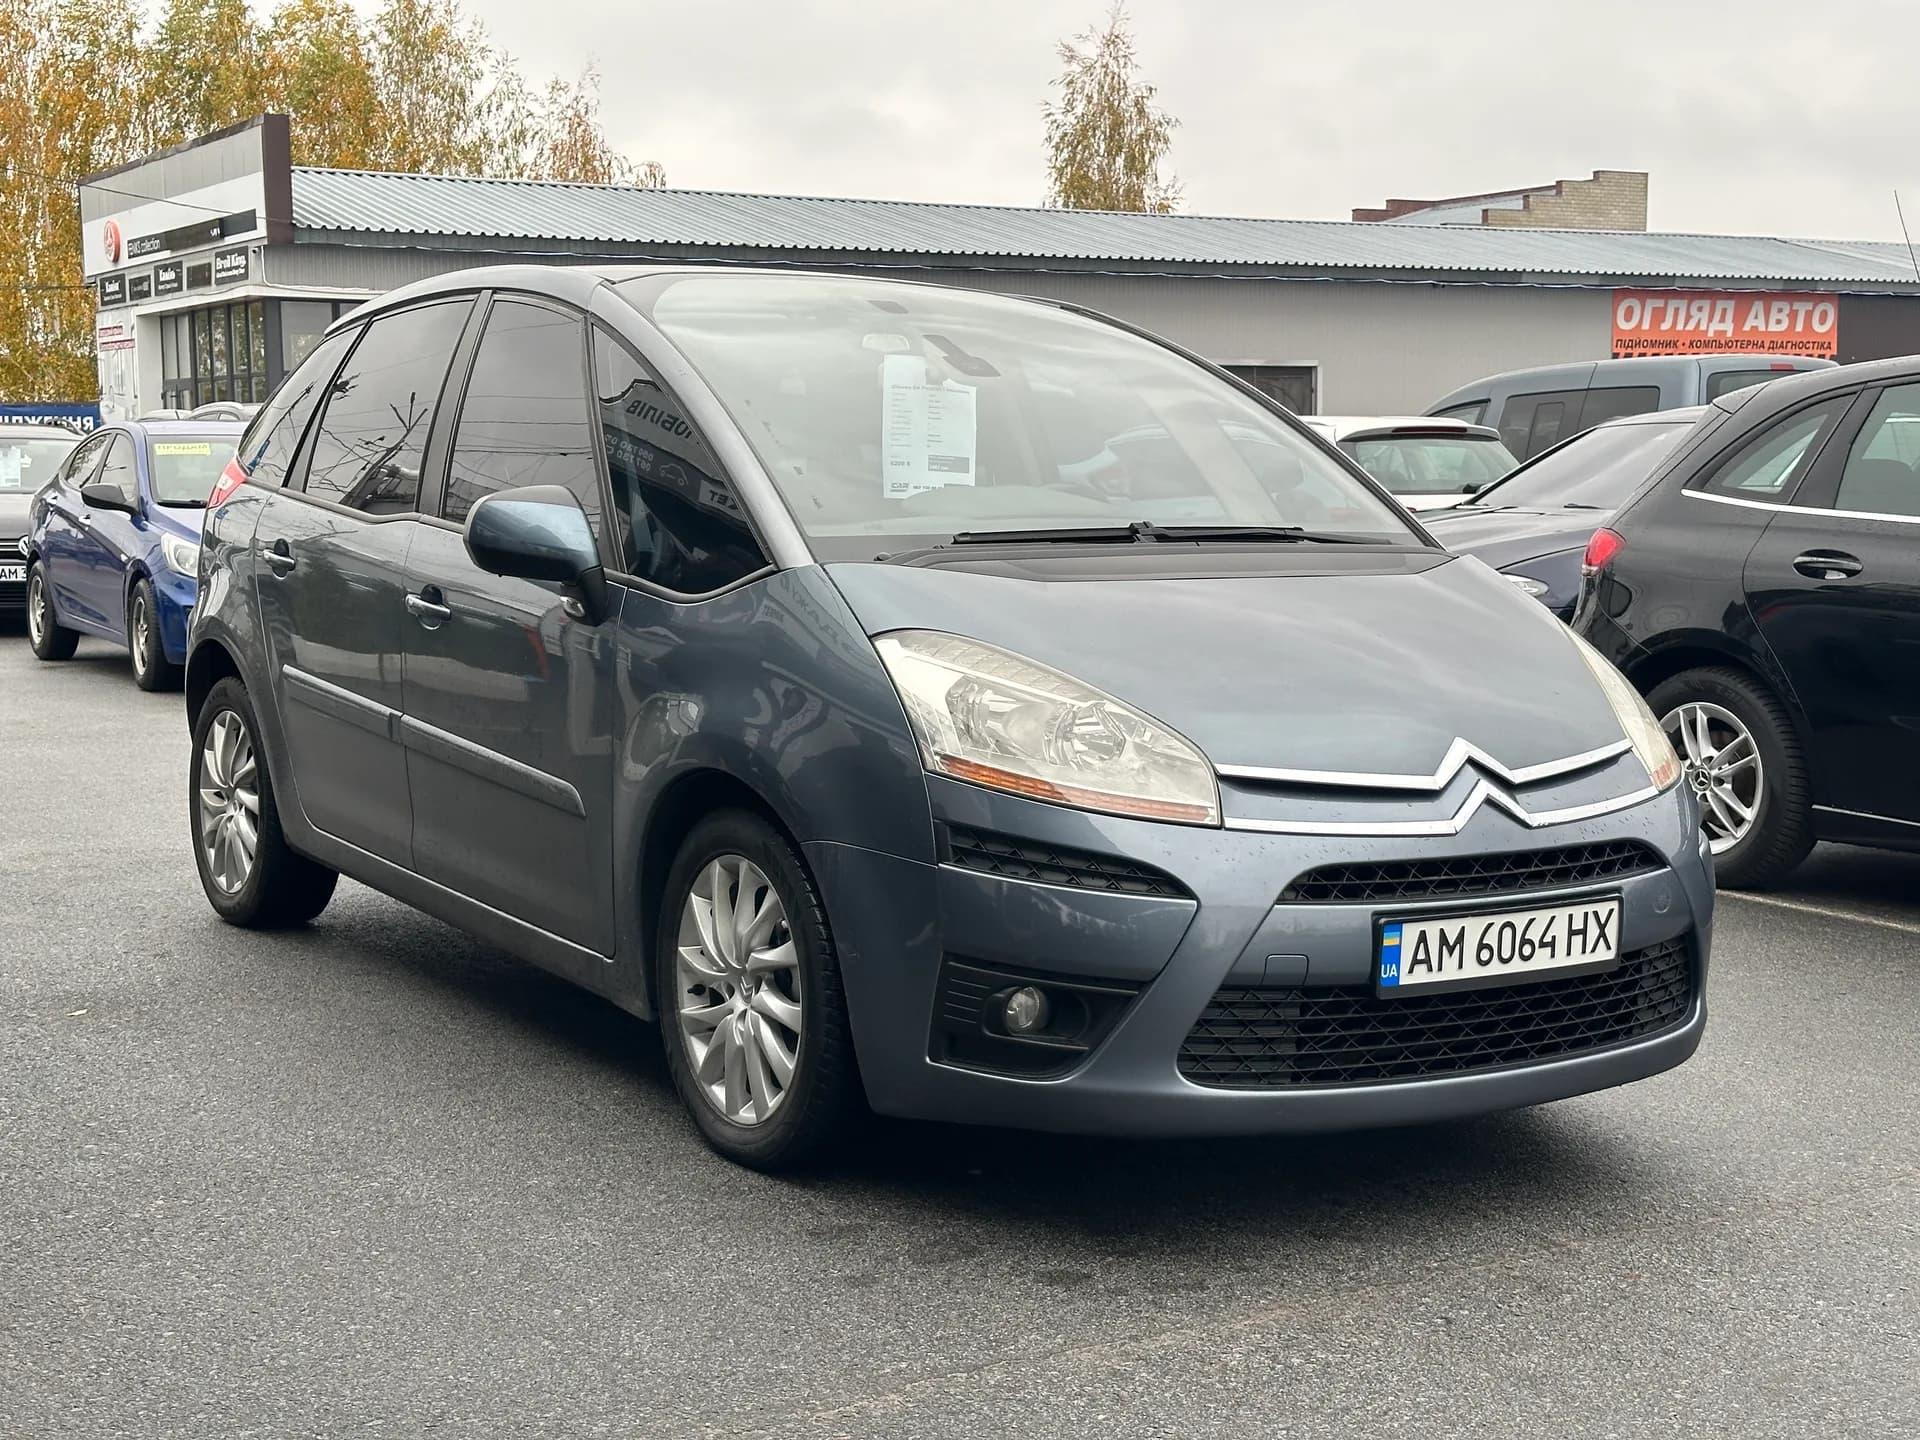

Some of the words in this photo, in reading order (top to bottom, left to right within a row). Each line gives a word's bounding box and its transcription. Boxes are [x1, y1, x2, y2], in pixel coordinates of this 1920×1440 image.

[1616, 298, 1736, 337] ОГЛЯД
[1743, 301, 1836, 334] АВТО
[1615, 337, 1680, 350] ПІДЙОМНИК
[1688, 338, 1766, 350] КОМПЬЮТЕРНА
[1767, 340, 1833, 351] ДІАГНОСТІКА
[0, 567, 18, 580] AM
[1408, 925, 1466, 974] AM
[1475, 914, 1557, 967] 6064
[1566, 907, 1615, 957] HX
[1381, 963, 1398, 979] UA
